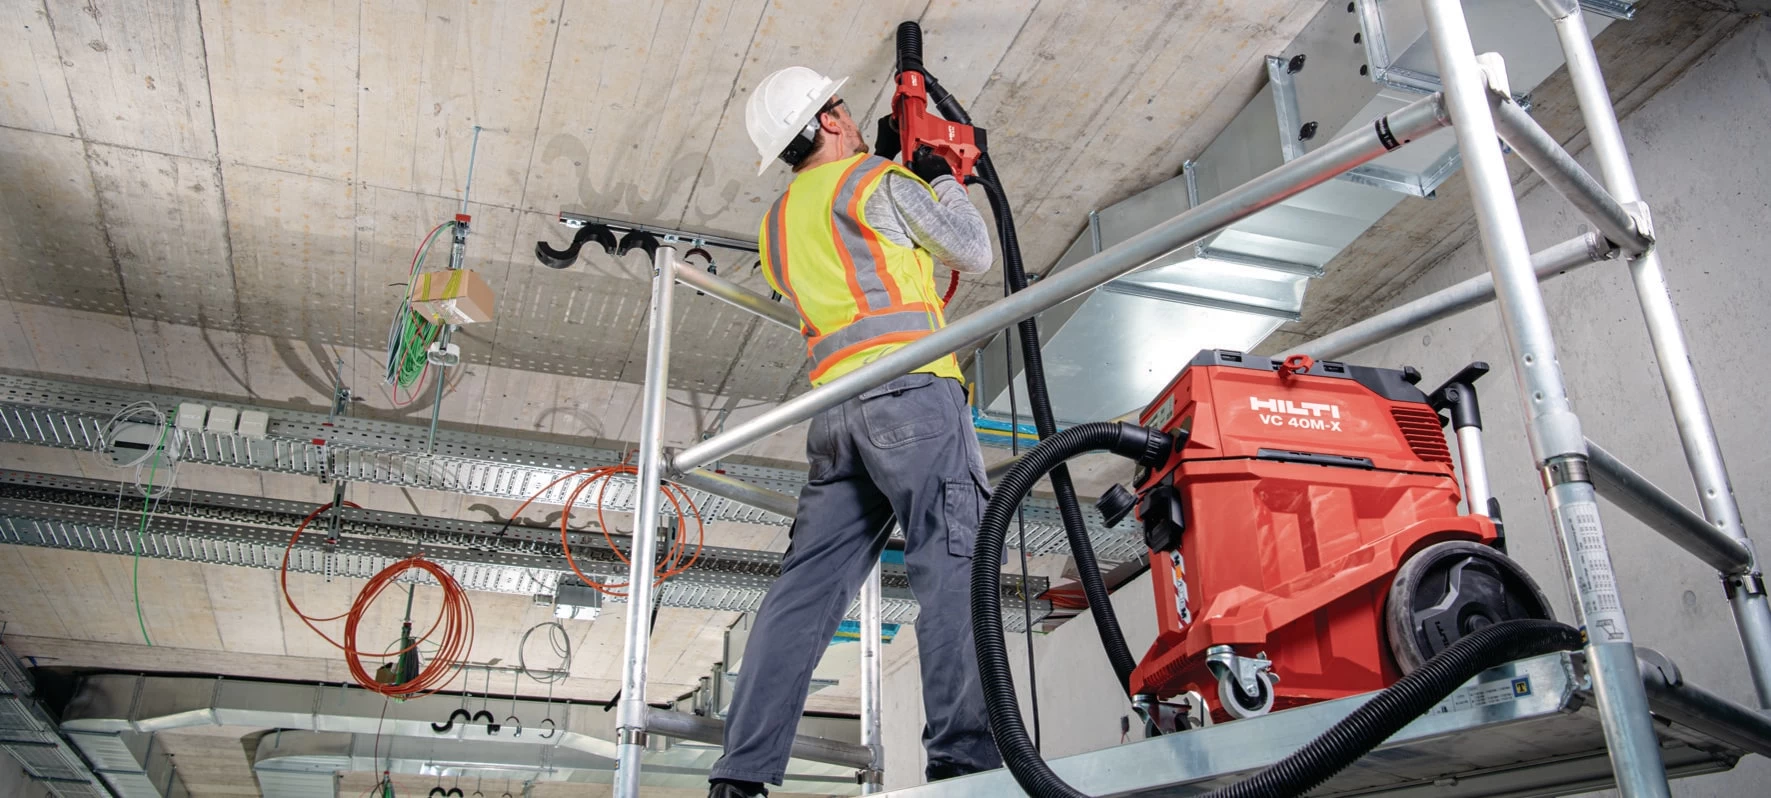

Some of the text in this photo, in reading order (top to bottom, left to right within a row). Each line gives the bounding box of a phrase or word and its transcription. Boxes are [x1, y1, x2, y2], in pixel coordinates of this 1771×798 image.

[1249, 396, 1340, 419] HILTI
[1259, 413, 1342, 432] VC 40M-X
[1435, 621, 1450, 649] ILTI
